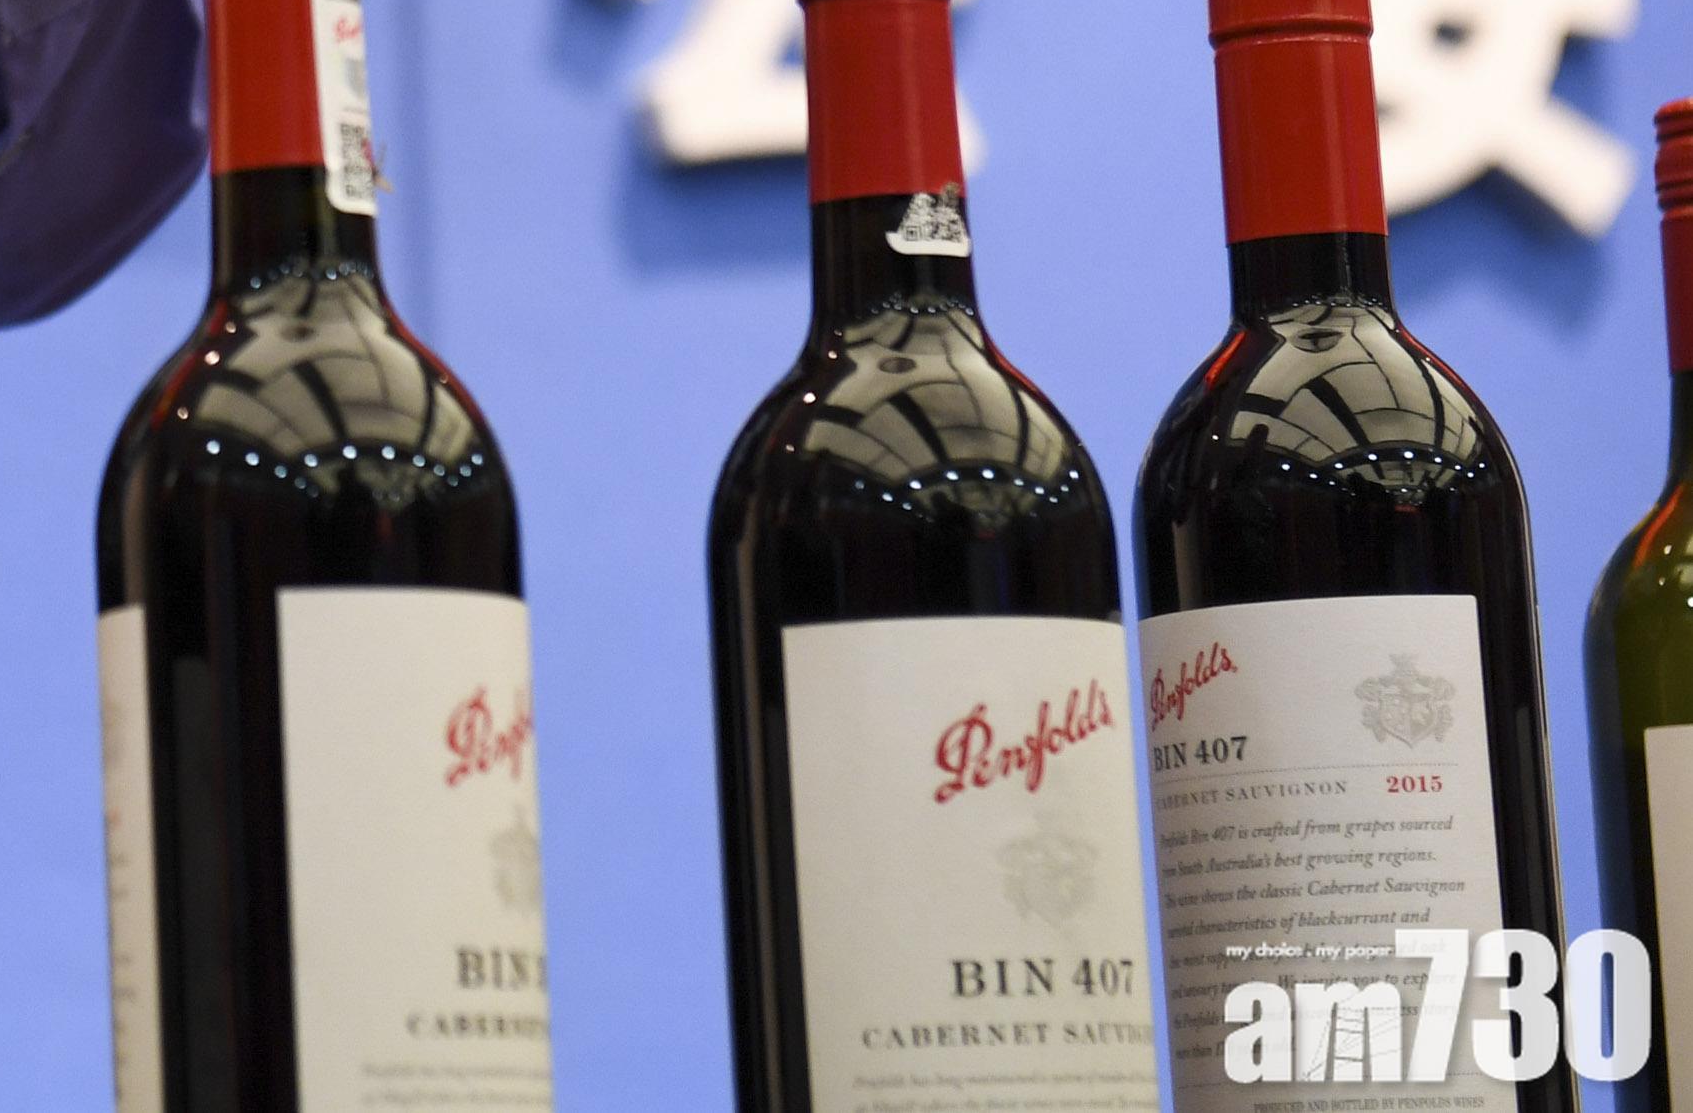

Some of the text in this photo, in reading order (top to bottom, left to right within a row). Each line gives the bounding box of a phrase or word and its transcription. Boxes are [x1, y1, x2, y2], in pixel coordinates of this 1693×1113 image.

[933, 678, 1115, 805] Penfolds
[1153, 736, 1247, 772] BIN 407
[1225, 781, 1348, 803] SAUVIGNON
[1386, 775, 1443, 794] 2015
[1252, 820, 1302, 843] crafted
[1301, 818, 1341, 843] from
[1344, 817, 1395, 840] grapes
[1399, 815, 1455, 832] sourced
[1274, 852, 1303, 868] best
[1305, 849, 1374, 871] growing
[1378, 848, 1437, 868] regions.
[1260, 883, 1303, 899] classic
[1307, 879, 1379, 897] Cabernet
[1383, 877, 1466, 897] Sauvignon
[1298, 909, 1397, 929] blackcurrant
[1400, 907, 1431, 924] and
[952, 958, 1057, 998] BIN
[1072, 956, 1134, 996] 407
[1383, 972, 1400, 986] to
[861, 1022, 1048, 1049] CABERNET
